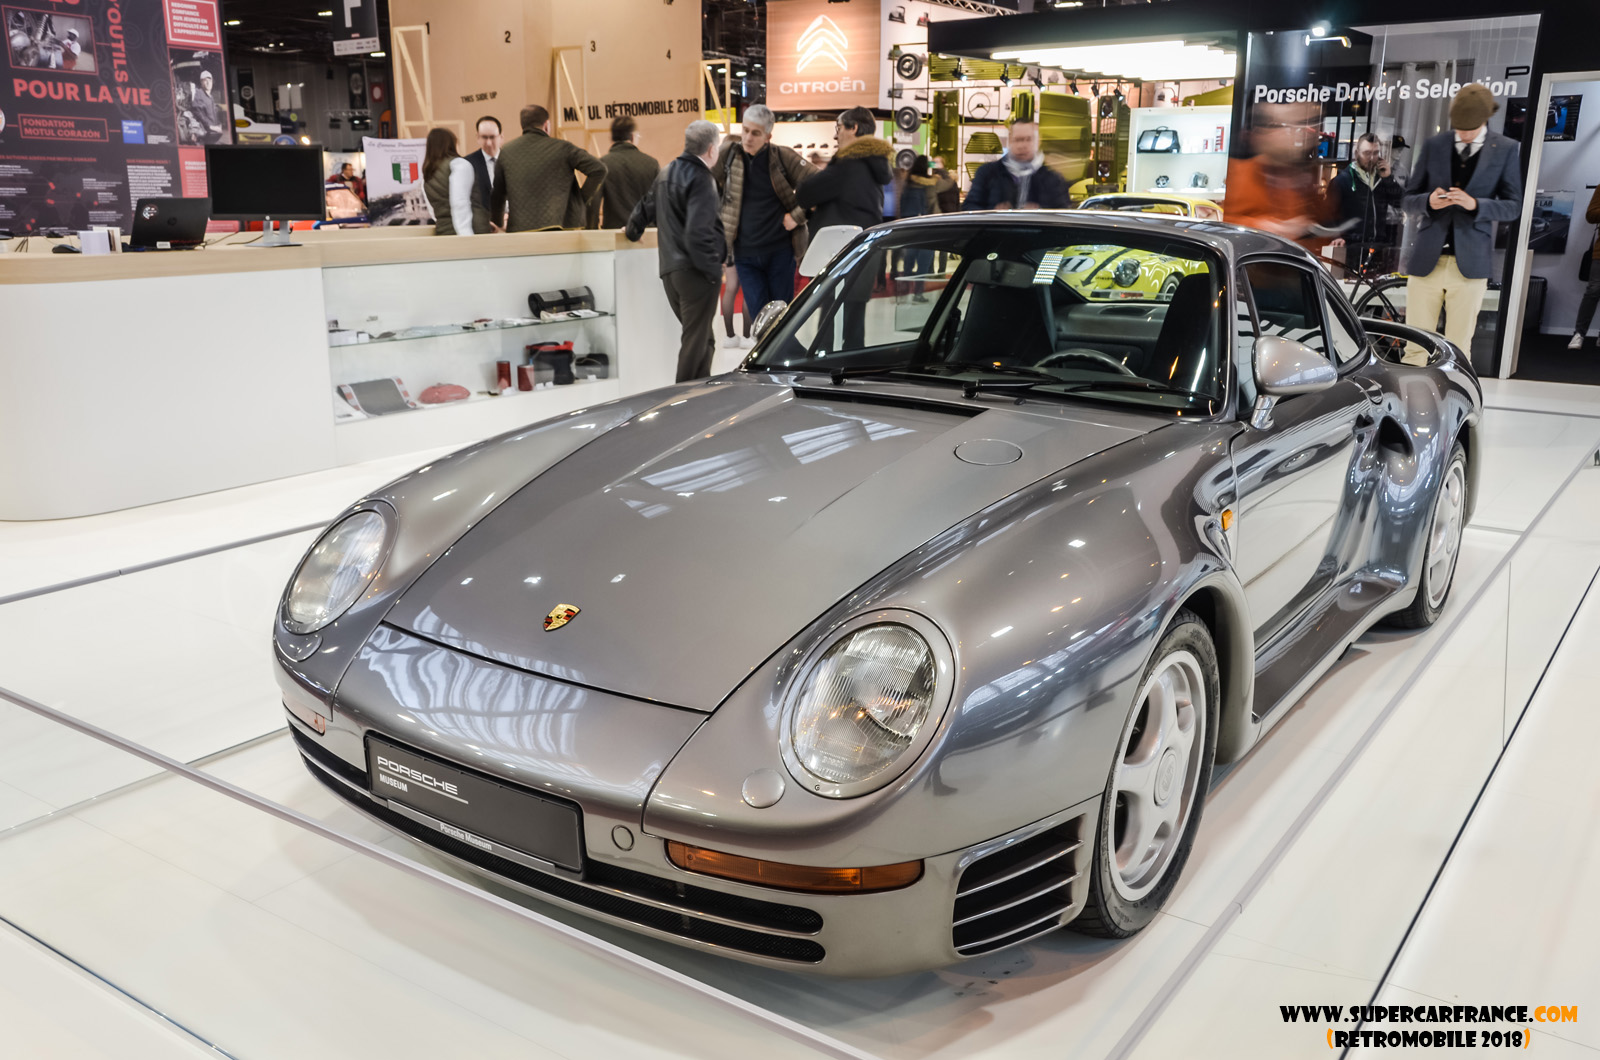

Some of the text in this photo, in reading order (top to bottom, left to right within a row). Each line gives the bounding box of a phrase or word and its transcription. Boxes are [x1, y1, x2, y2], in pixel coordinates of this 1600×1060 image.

[107, 0, 129, 83] 'OUTILS
[504, 31, 512, 43] 2
[590, 41, 596, 52] 3
[666, 49, 672, 60] 4
[13, 78, 152, 106] POUR LA VIE
[460, 91, 497, 104] THIS SIDE UP
[1254, 76, 1518, 104] Porsche Driver's Seleion
[563, 98, 699, 122] MOUL RÉTROMOBILE 2018
[22, 118, 75, 129] FONDATION
[24, 127, 101, 139] MOTUL CORAZÓN
[377, 755, 458, 796] PORSCHE
[379, 773, 408, 793] MUSEUM
[440, 822, 492, 851] Porsche Museum
